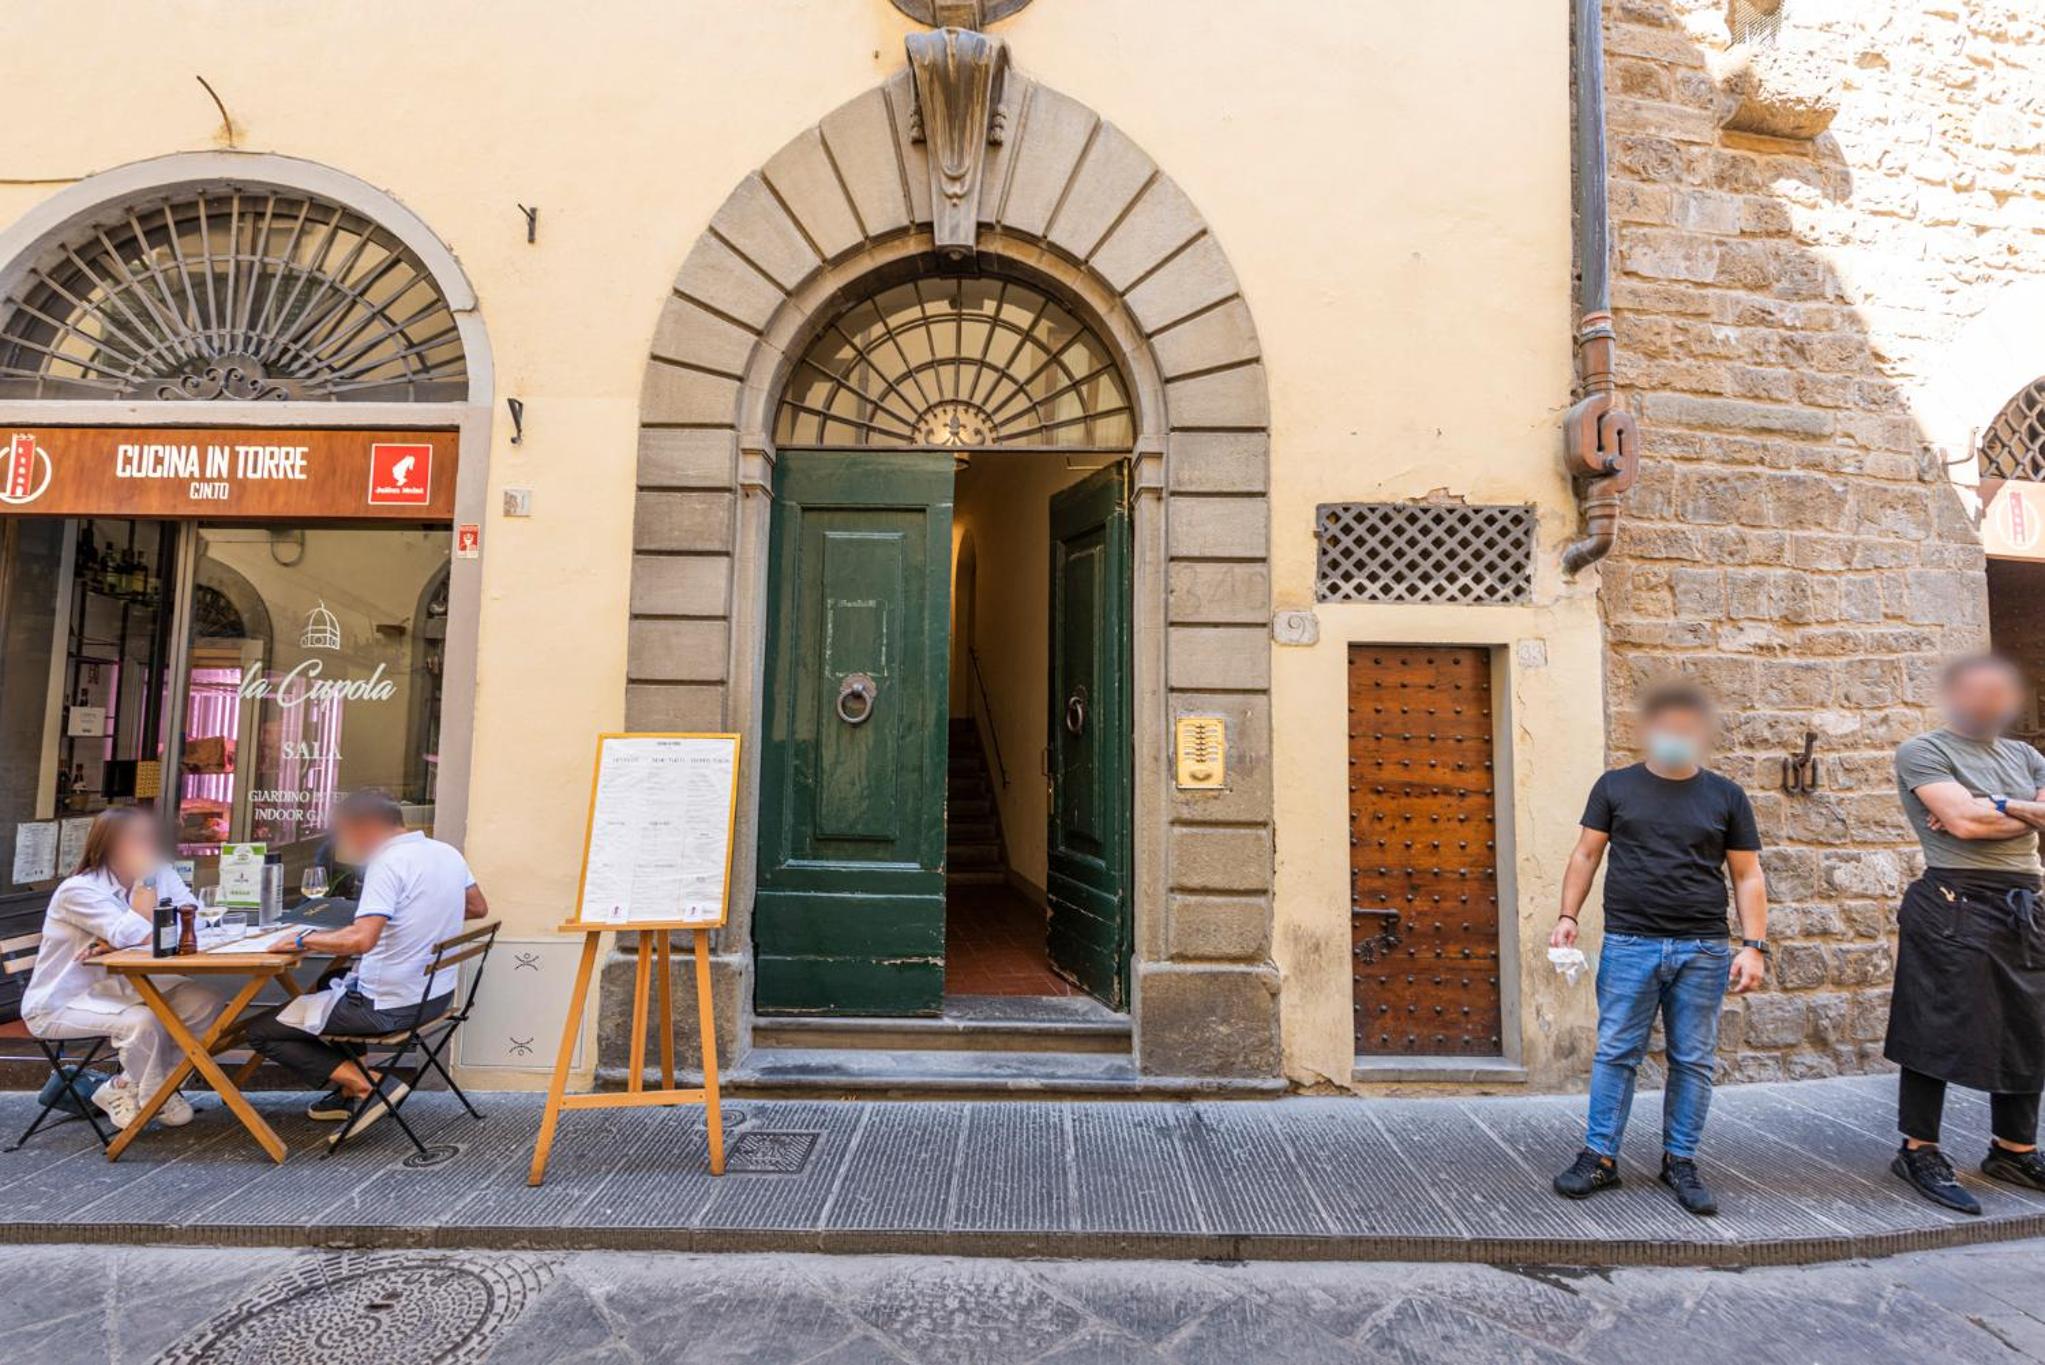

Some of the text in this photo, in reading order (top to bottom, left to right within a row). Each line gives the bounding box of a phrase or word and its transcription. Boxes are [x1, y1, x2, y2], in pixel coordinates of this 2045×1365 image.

[115, 444, 309, 480] CUCINA IN TORRE
[238, 658, 398, 712] la Cupola
[282, 742, 343, 760] SALA
[248, 789, 310, 803] GIARDINO
[254, 807, 304, 821] INDOOR
